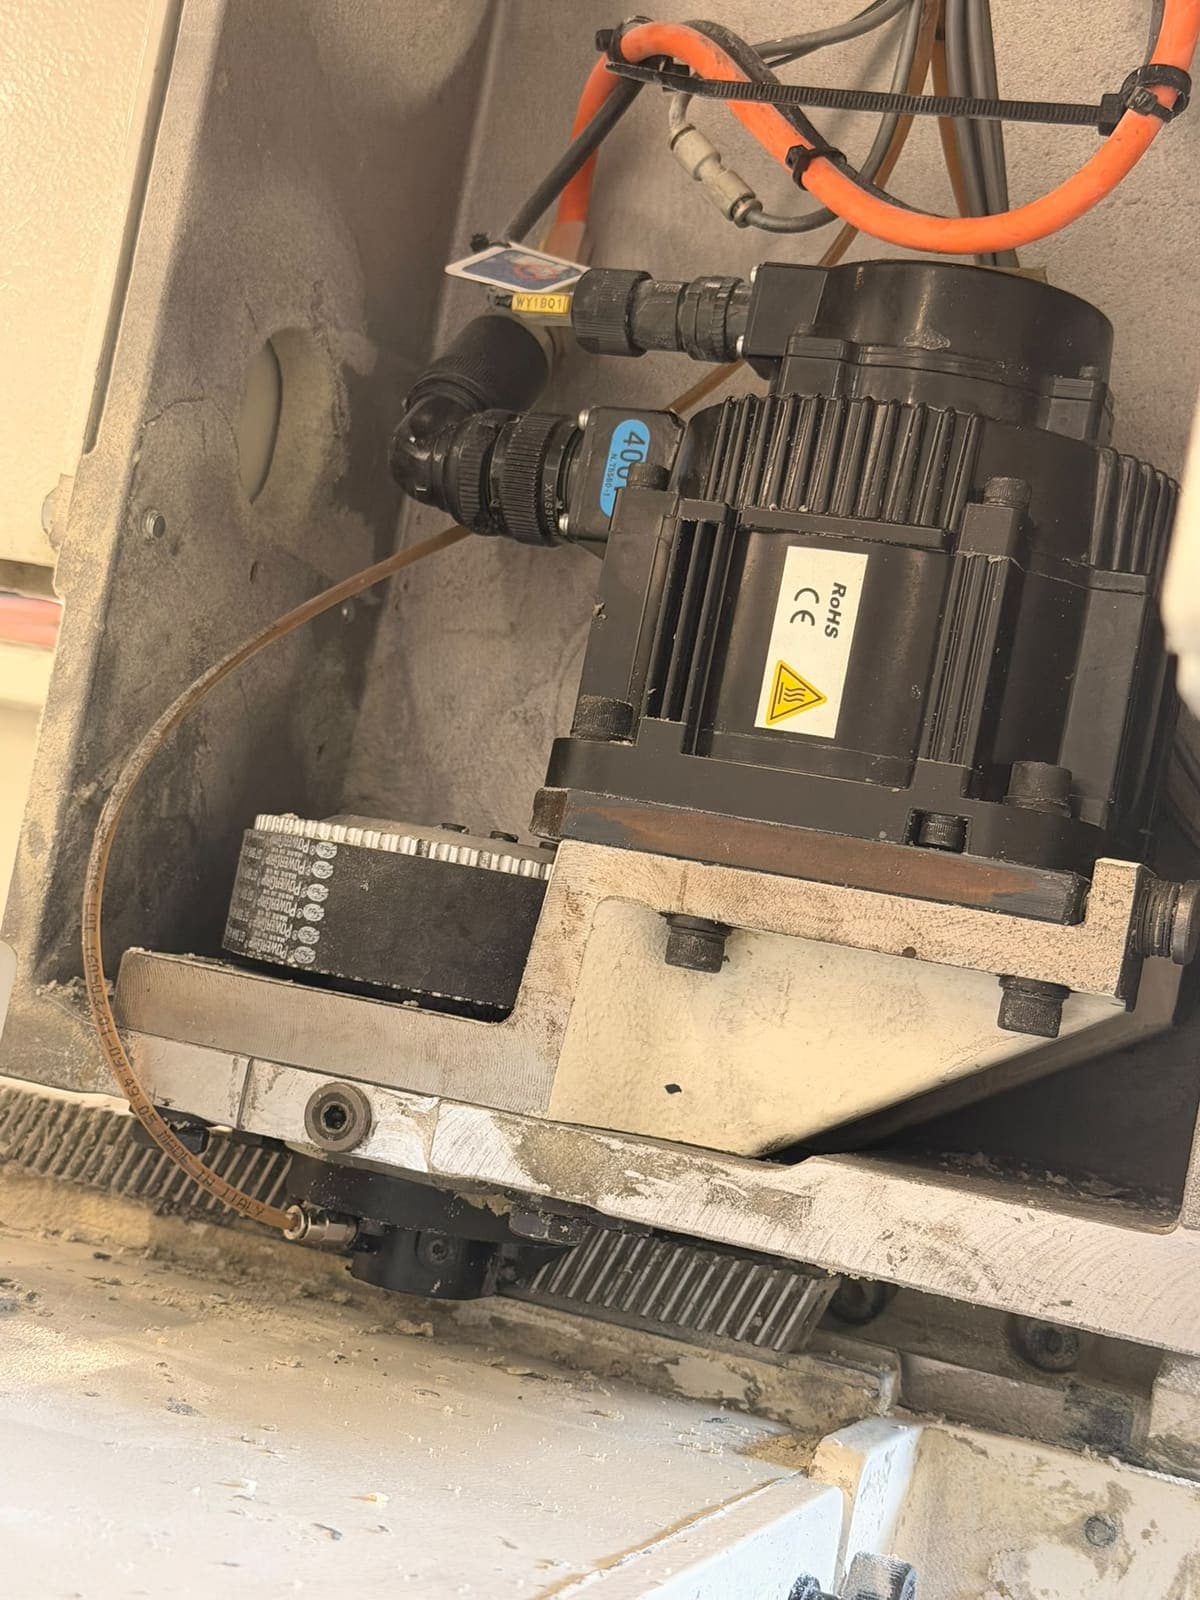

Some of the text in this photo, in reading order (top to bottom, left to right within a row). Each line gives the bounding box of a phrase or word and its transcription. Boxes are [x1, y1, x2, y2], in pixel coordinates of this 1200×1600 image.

[789, 587, 820, 627] CE
[824, 582, 847, 639] RoHS
[158, 1130, 193, 1165] MADE
[196, 1168, 216, 1187] IN
[221, 1187, 265, 1217] ITALY
